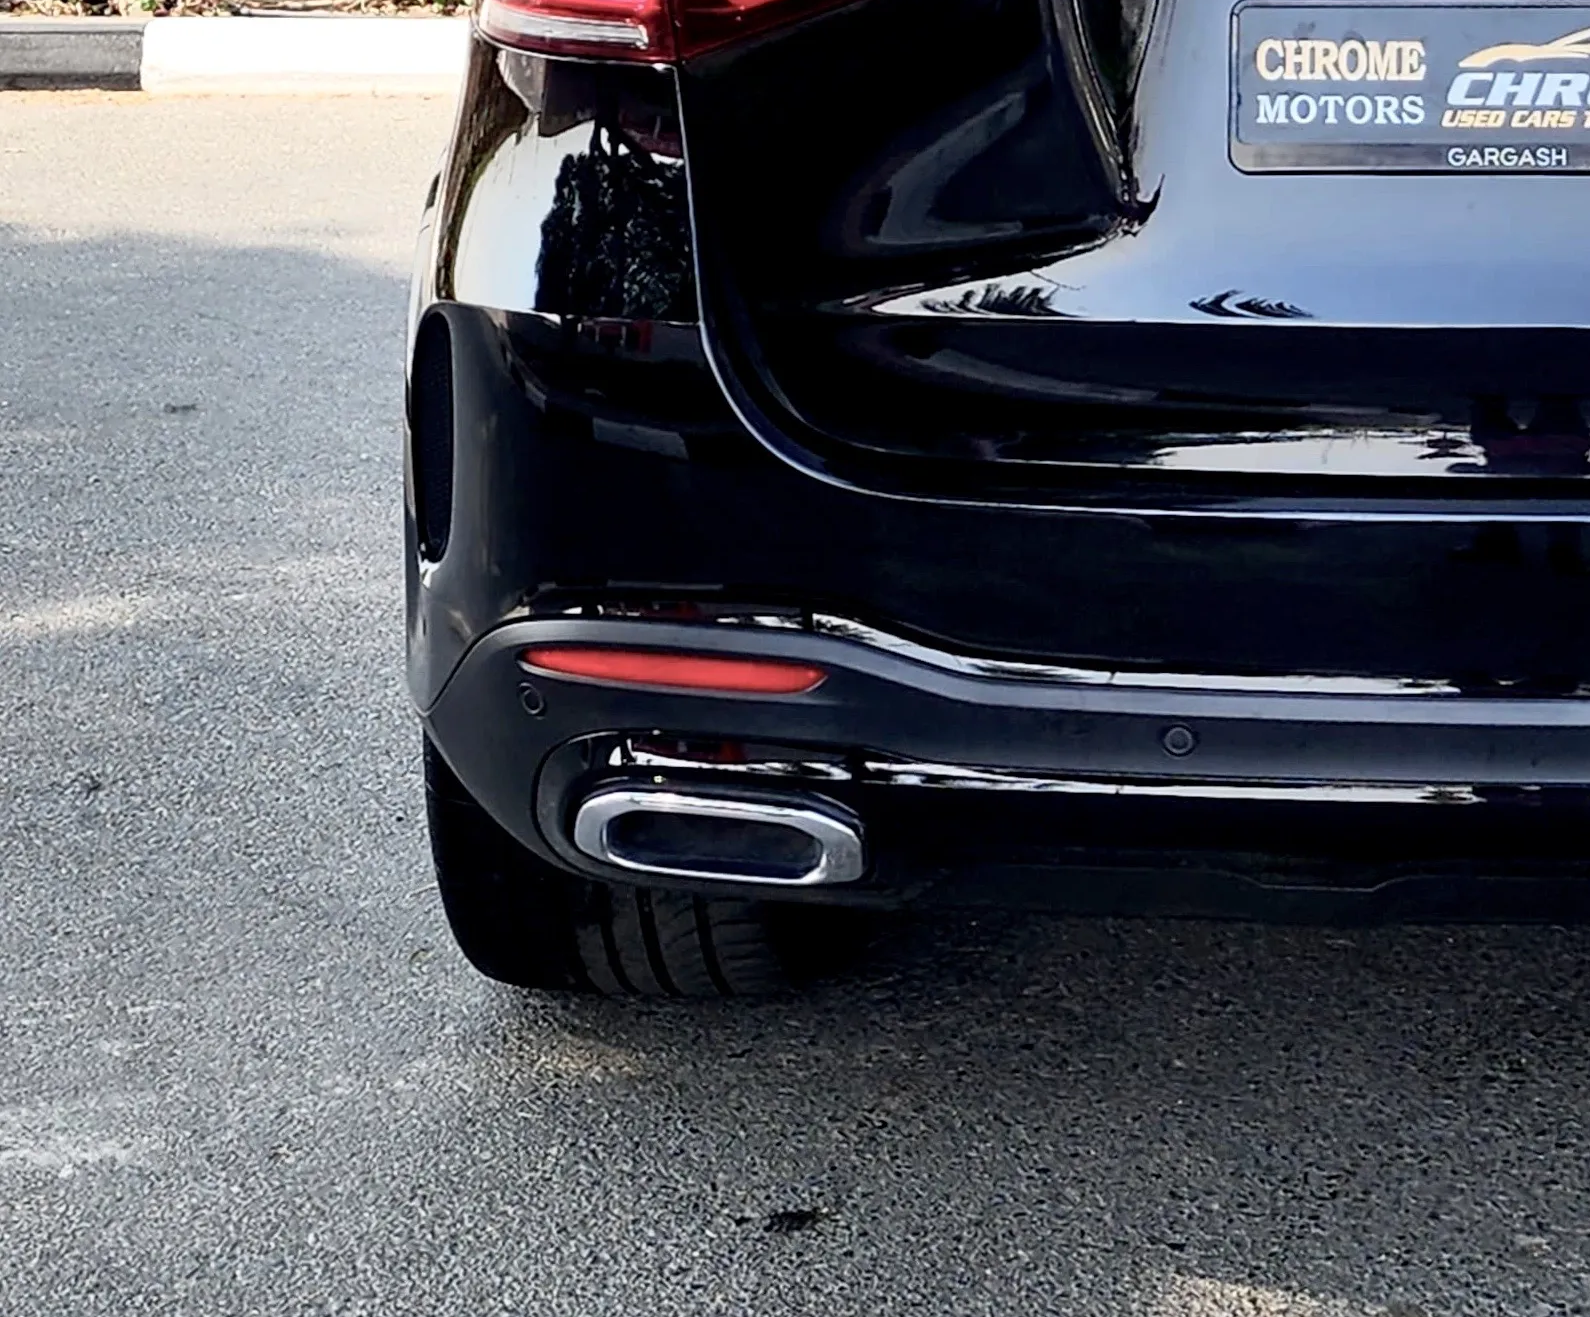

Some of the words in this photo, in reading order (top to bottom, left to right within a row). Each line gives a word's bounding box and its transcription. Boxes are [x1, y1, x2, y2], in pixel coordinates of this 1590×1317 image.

[1256, 39, 1426, 81] CHROME
[1256, 94, 1425, 125] MOTORS
[1441, 109, 1504, 128] USED
[1510, 110, 1576, 128] CARS
[1447, 147, 1567, 167] GARGASH
